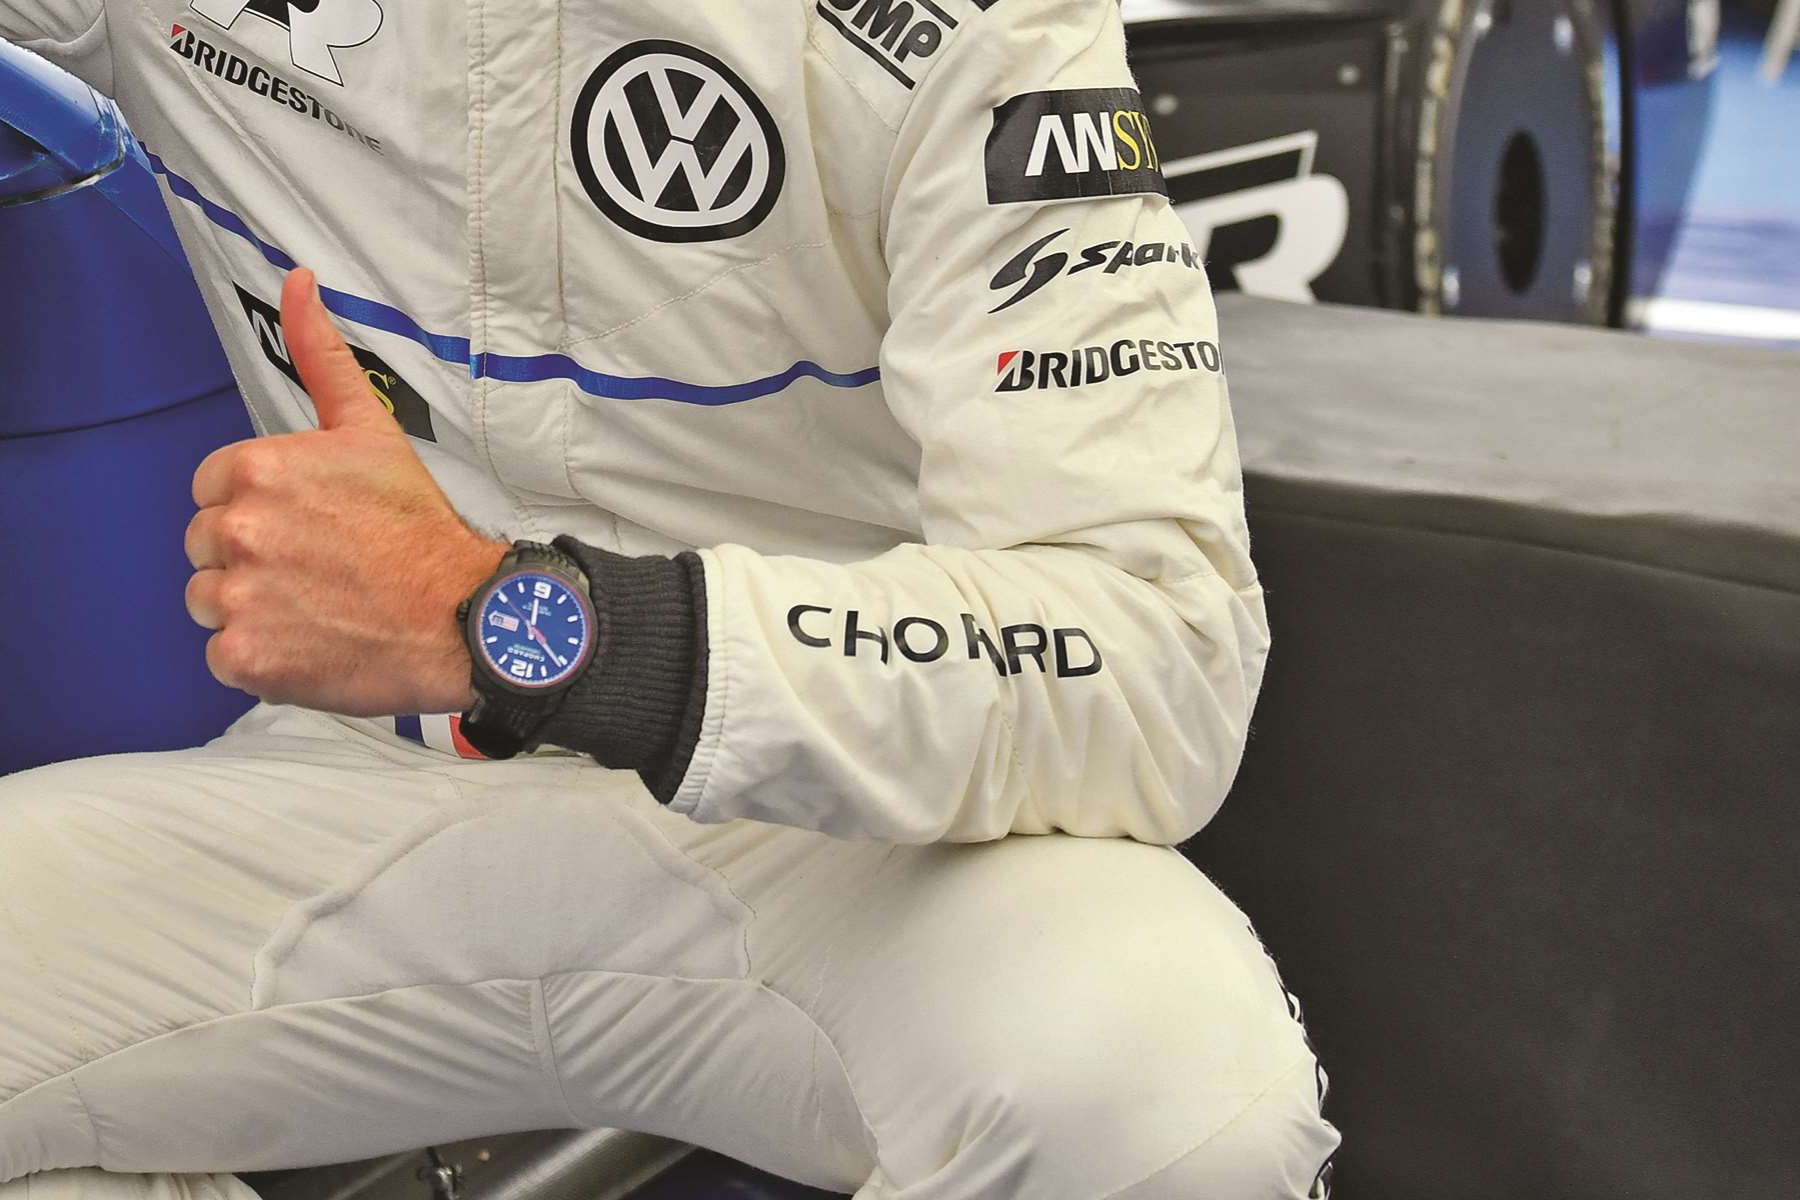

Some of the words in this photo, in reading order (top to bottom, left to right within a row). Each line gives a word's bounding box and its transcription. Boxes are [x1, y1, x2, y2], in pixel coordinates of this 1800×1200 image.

[169, 23, 384, 155] BRIDGESTONE
[1025, 110, 1159, 177] ANSY
[995, 339, 1225, 393] BRIDGESTO
